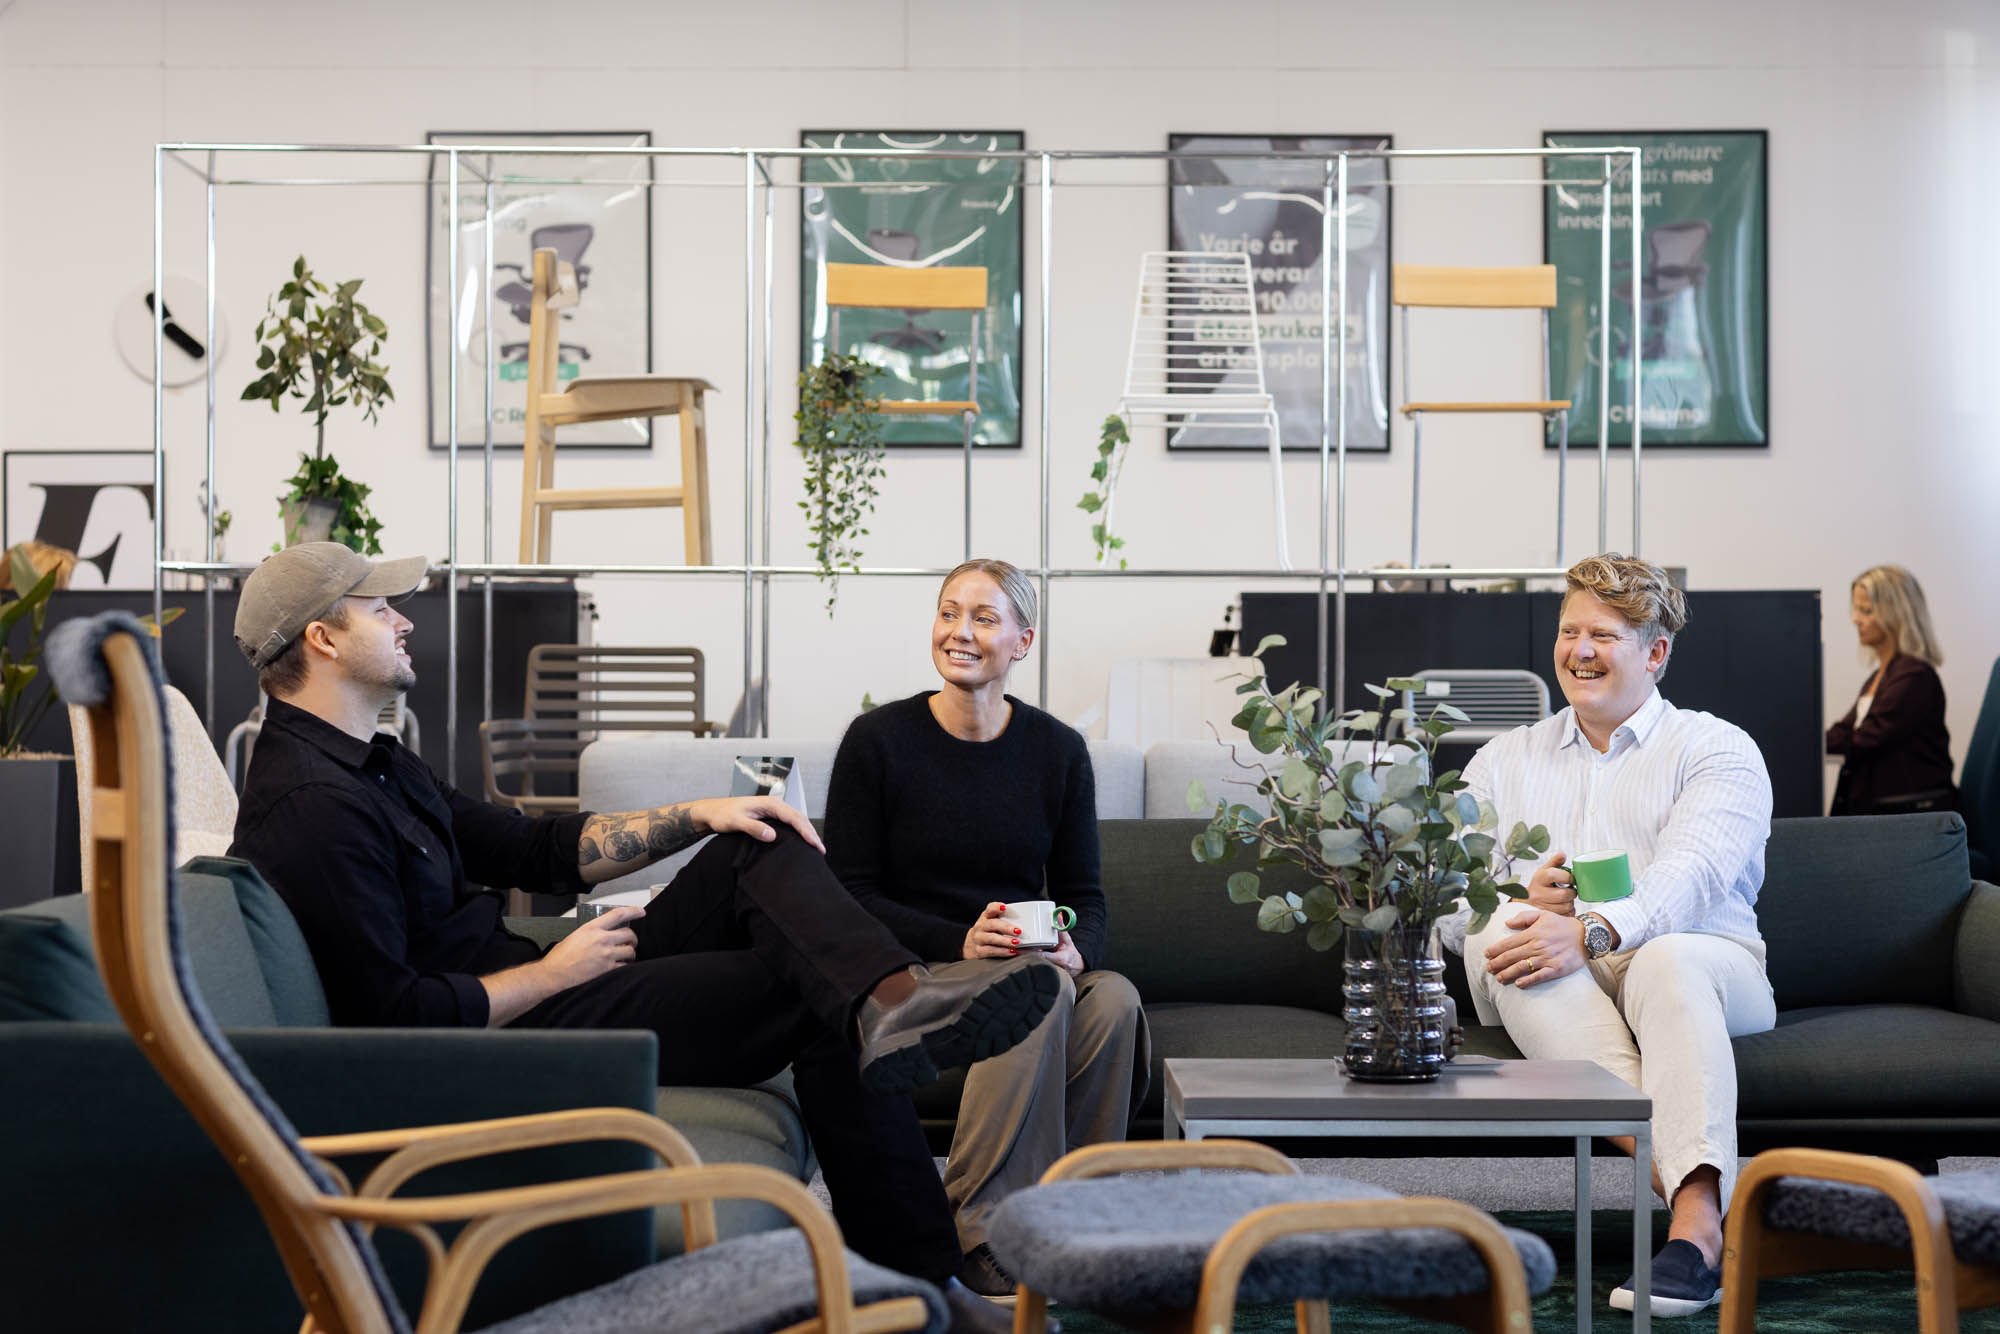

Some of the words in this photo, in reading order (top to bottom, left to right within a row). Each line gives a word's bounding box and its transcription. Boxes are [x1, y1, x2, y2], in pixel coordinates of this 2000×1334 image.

[1672, 166, 1713, 185] med
[1199, 231, 1265, 258] Varje
[1269, 230, 1300, 256] år
[1198, 346, 1368, 374] arbesplaser
